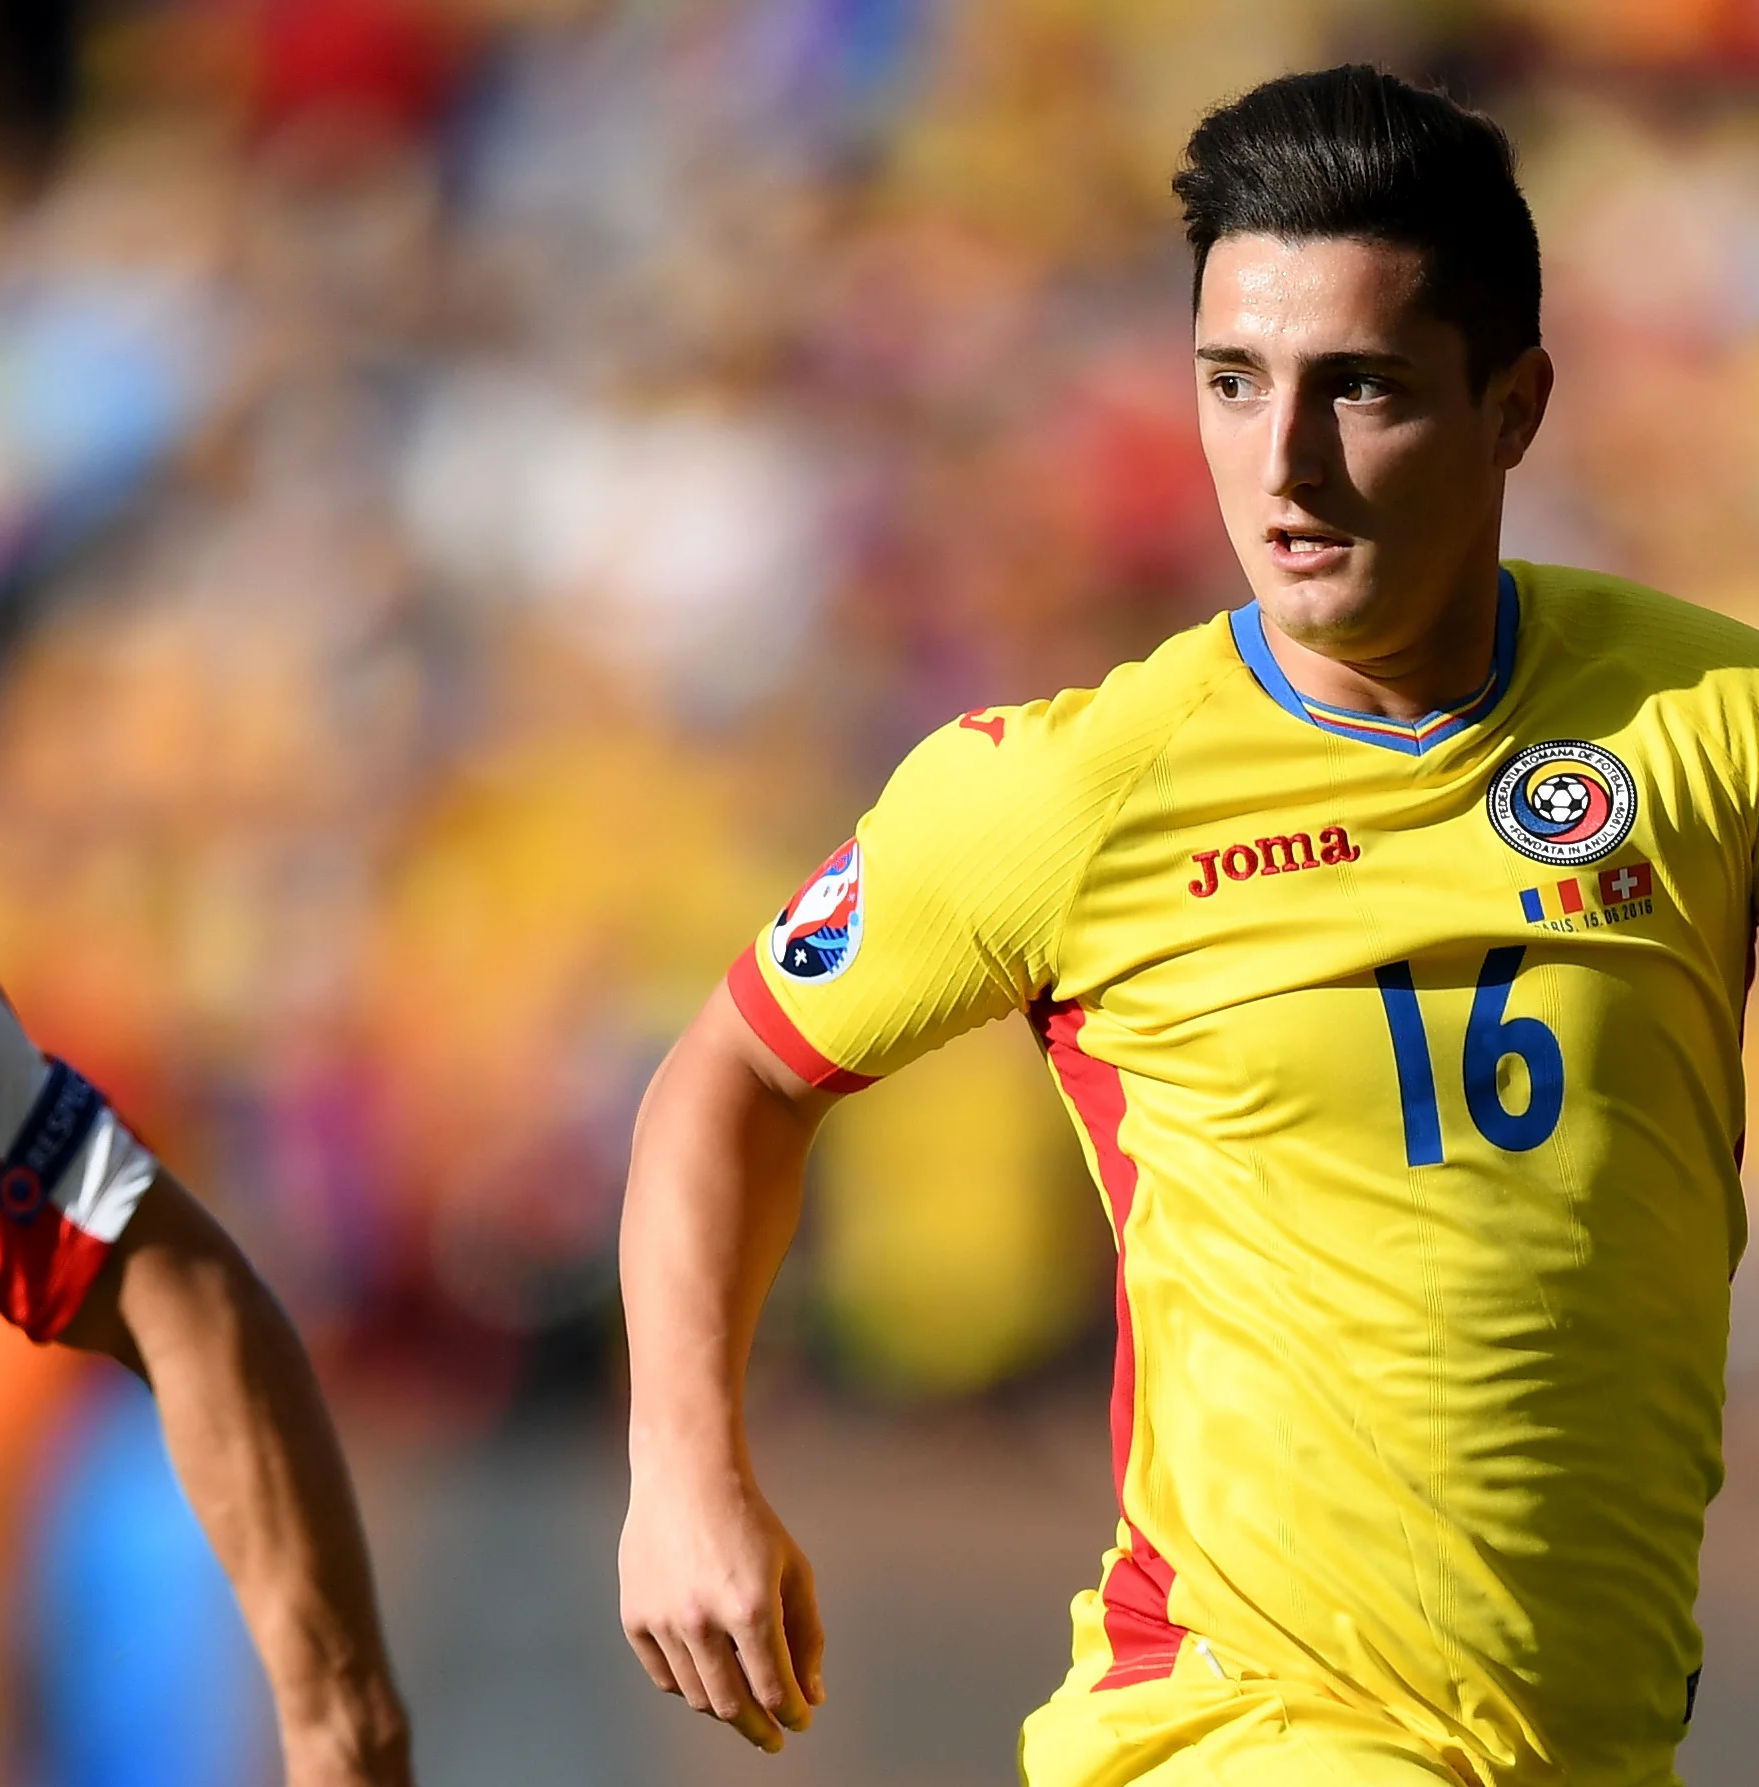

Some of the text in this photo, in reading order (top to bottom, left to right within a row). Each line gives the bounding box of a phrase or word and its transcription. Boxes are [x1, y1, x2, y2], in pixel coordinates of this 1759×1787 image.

[1521, 748, 1575, 768] ROMANA
[1577, 750, 1596, 762] DE
[1595, 757, 1626, 797] FOTBAL
[1568, 846, 1581, 856] IN
[1584, 831, 1616, 853] ANUL
[1373, 944, 1565, 1167] 16
